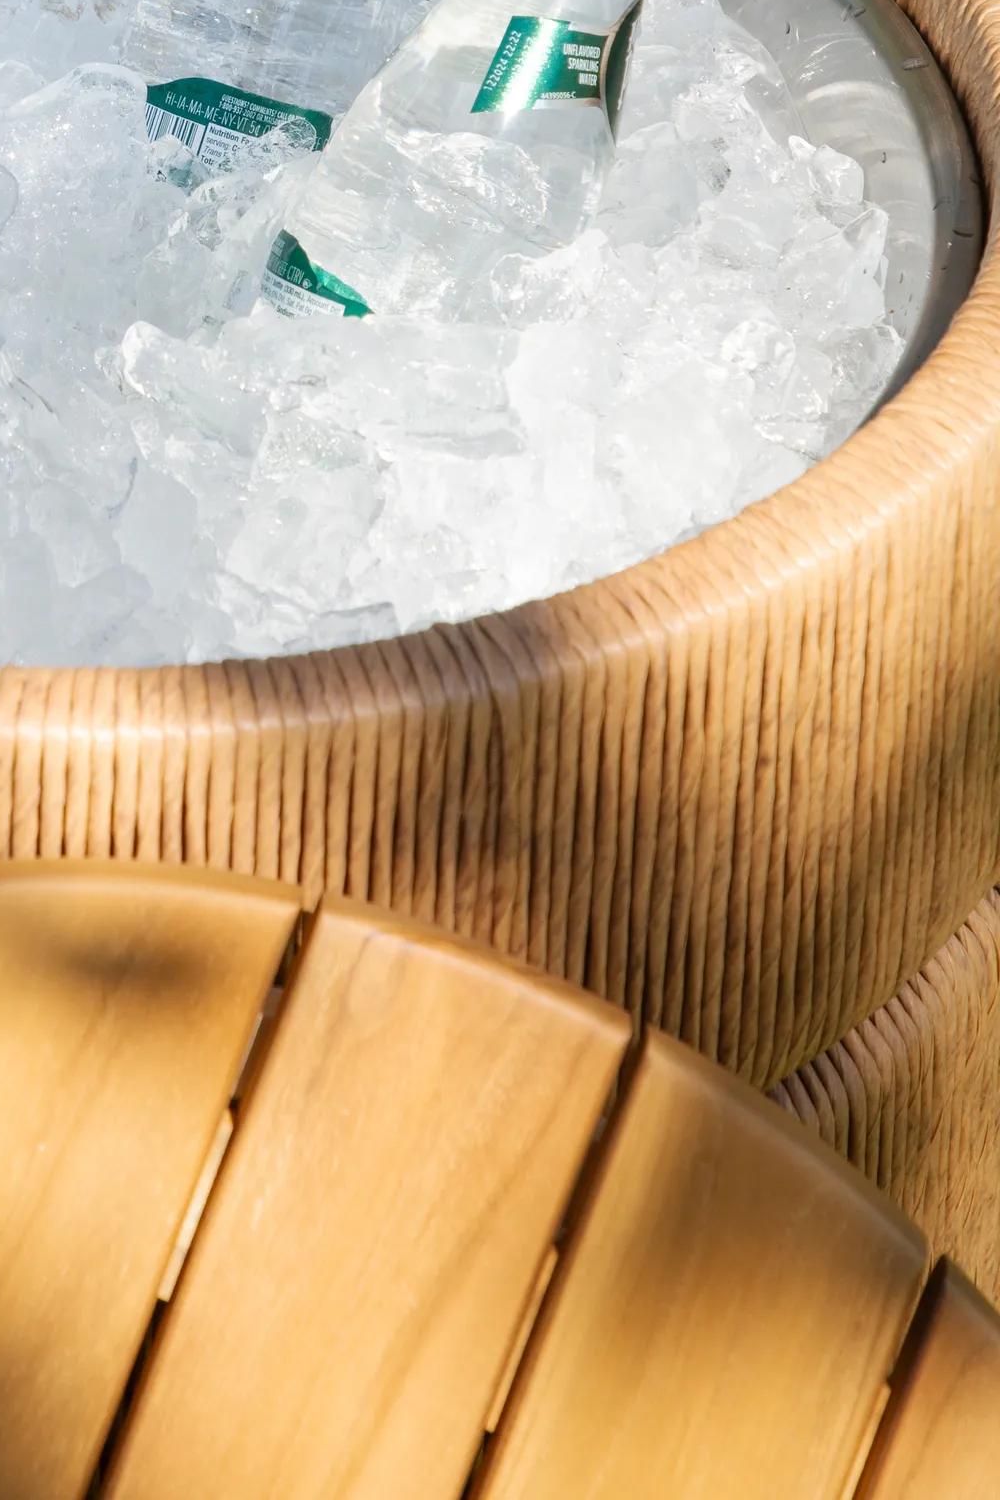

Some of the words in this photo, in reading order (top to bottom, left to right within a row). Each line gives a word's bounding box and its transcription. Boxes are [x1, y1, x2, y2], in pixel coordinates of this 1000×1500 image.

[563, 43, 600, 59] UNFLAVORED
[483, 57, 508, 91] 122024
[503, 30, 522, 58] 22:22
[568, 58, 599, 73] SPARKLING
[578, 73, 597, 87] WATER
[165, 91, 249, 132] HI-IA-MA-ME-NY-VT
[209, 125, 239, 142] Nutrition
